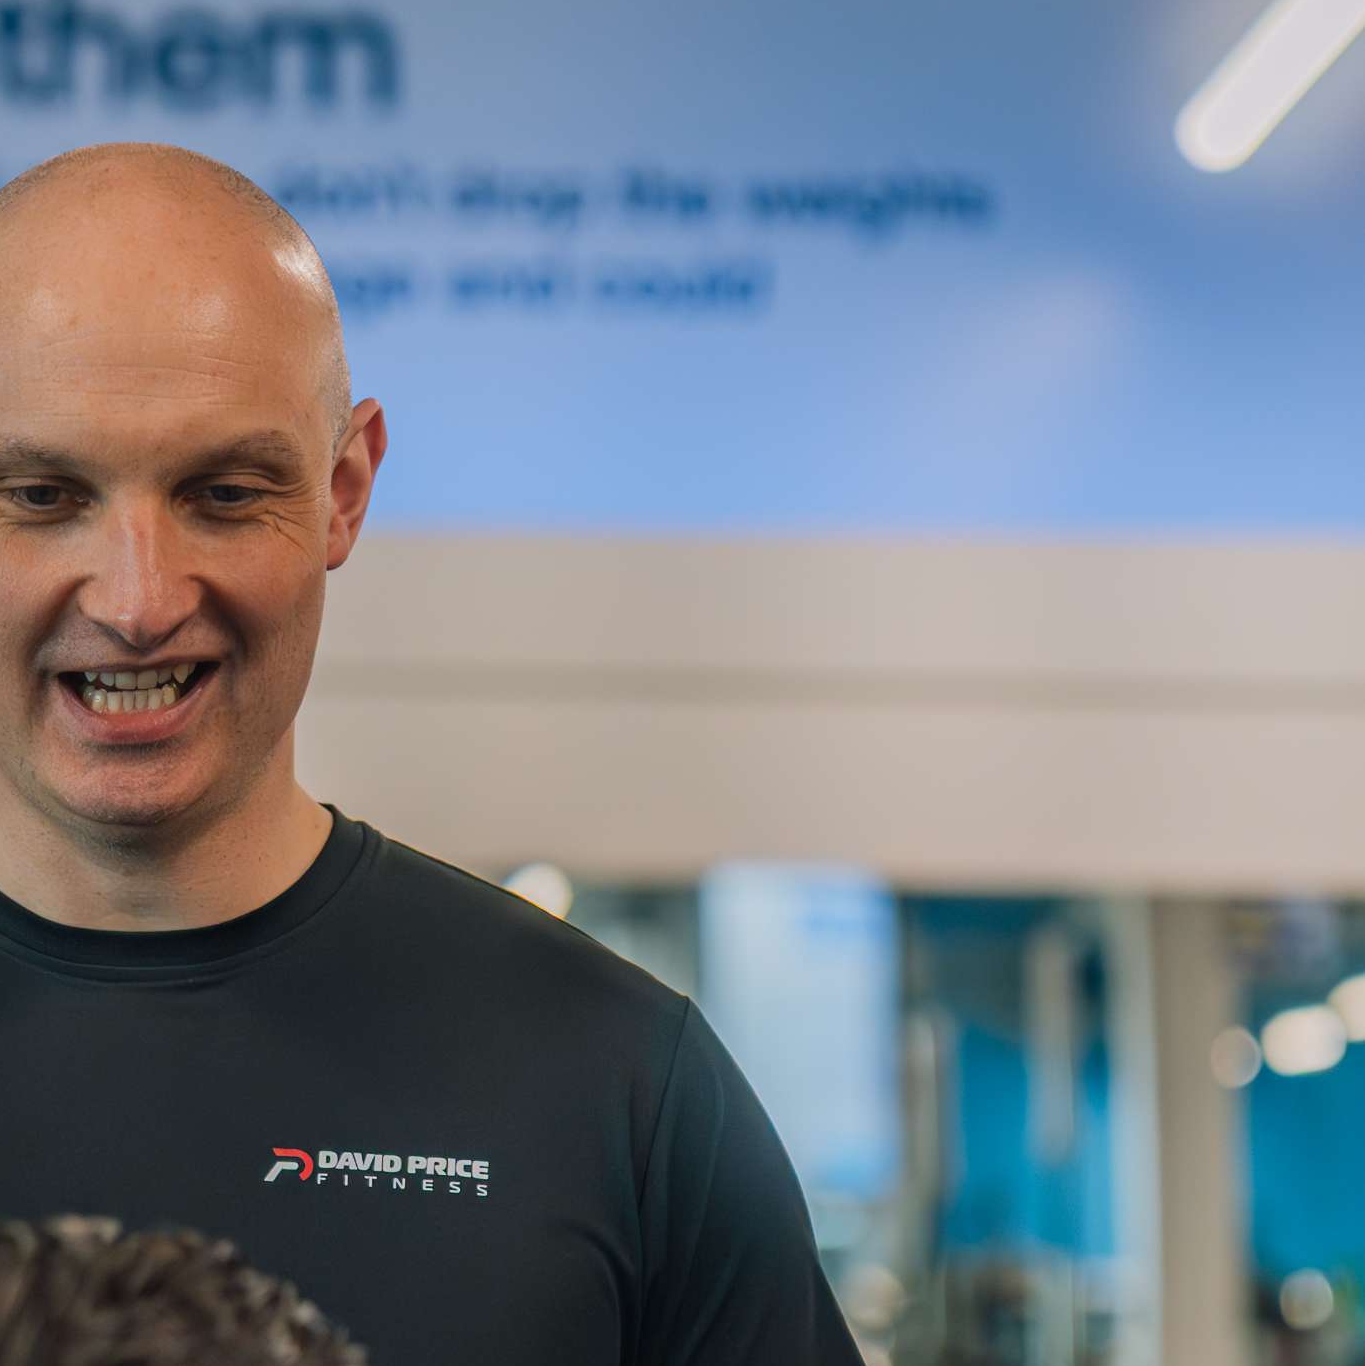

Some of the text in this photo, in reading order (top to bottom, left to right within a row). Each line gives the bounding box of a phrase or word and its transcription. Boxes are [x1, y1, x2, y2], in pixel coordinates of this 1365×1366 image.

[318, 1150, 489, 1180] DAVID PRICE
[316, 1173, 488, 1197] FITNESS
